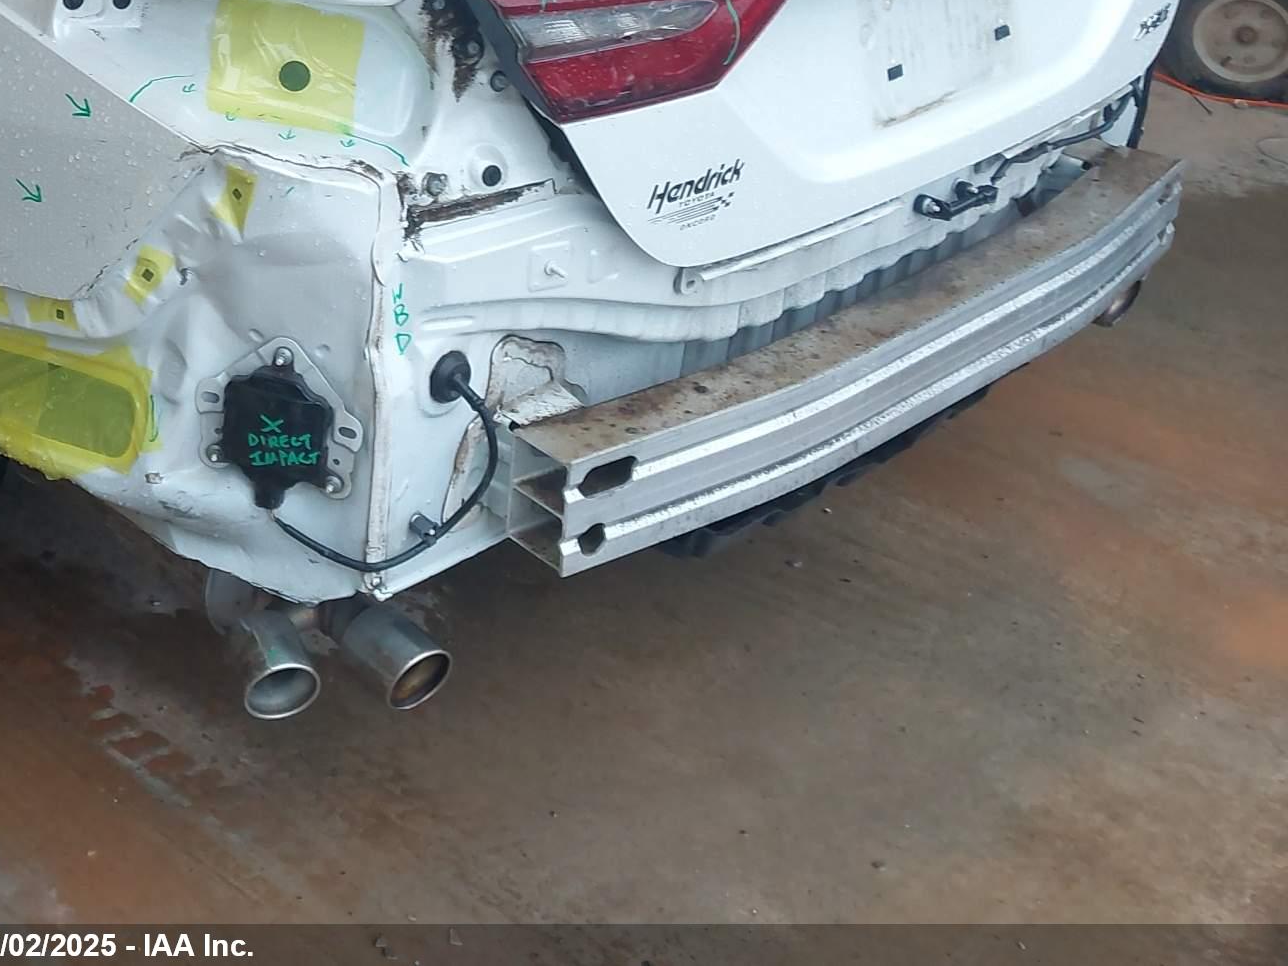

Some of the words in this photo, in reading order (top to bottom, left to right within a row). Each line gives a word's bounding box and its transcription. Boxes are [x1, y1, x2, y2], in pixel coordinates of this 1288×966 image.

[646, 157, 746, 215] Hendrick
[247, 432, 313, 451] DIRECT
[248, 449, 321, 467] IMPACT
